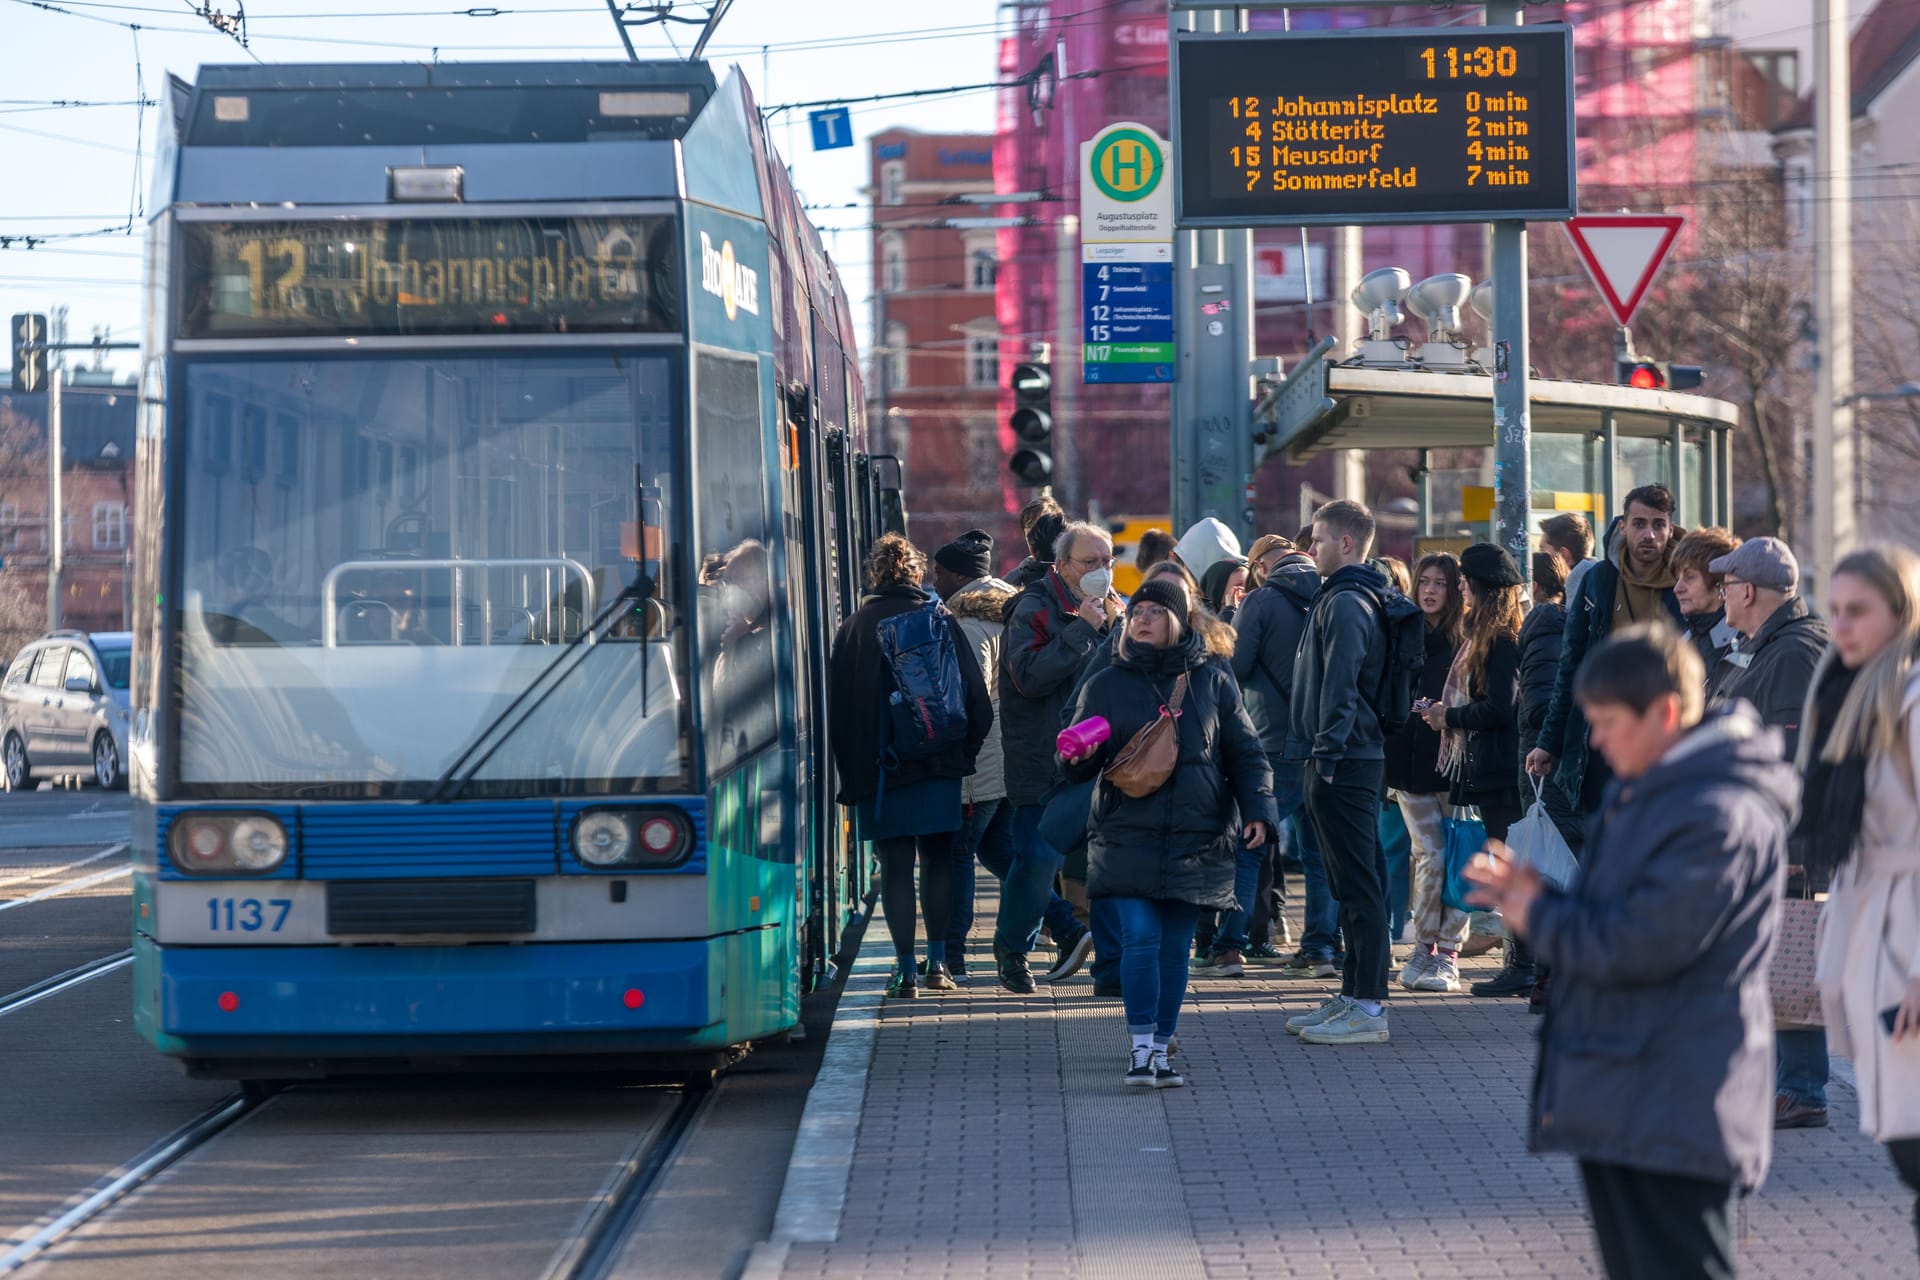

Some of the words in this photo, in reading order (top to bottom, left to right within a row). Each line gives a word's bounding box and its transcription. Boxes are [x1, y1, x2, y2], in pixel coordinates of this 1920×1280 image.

[1420, 46, 1517, 79] 11:30
[1228, 96, 1259, 118] 12
[1271, 92, 1438, 119] Johannisplatz
[1466, 91, 1481, 112] 0
[1485, 91, 1528, 112] min
[817, 113, 842, 145] T
[1245, 121, 1262, 142] 4
[1272, 119, 1385, 142] Stötteritz
[1466, 116, 1481, 137] 2
[1485, 115, 1528, 136] min
[1112, 145, 1142, 186] H
[1230, 146, 1261, 167] 15
[1272, 143, 1383, 167] Meusdorf
[1467, 140, 1483, 161] 4
[1486, 140, 1529, 161] min
[1246, 170, 1261, 191] 7
[1273, 166, 1417, 191] Sommerfeld
[1467, 165, 1482, 186] 7
[1486, 164, 1529, 185] min
[1096, 212, 1159, 223] Augustusplatz
[239, 239, 306, 318] 12
[1097, 265, 1110, 281] 4
[1098, 285, 1111, 301] 7
[1090, 305, 1110, 321] 12
[1090, 325, 1111, 341] 15
[1087, 345, 1112, 361] N17
[208, 898, 292, 932] 1137
